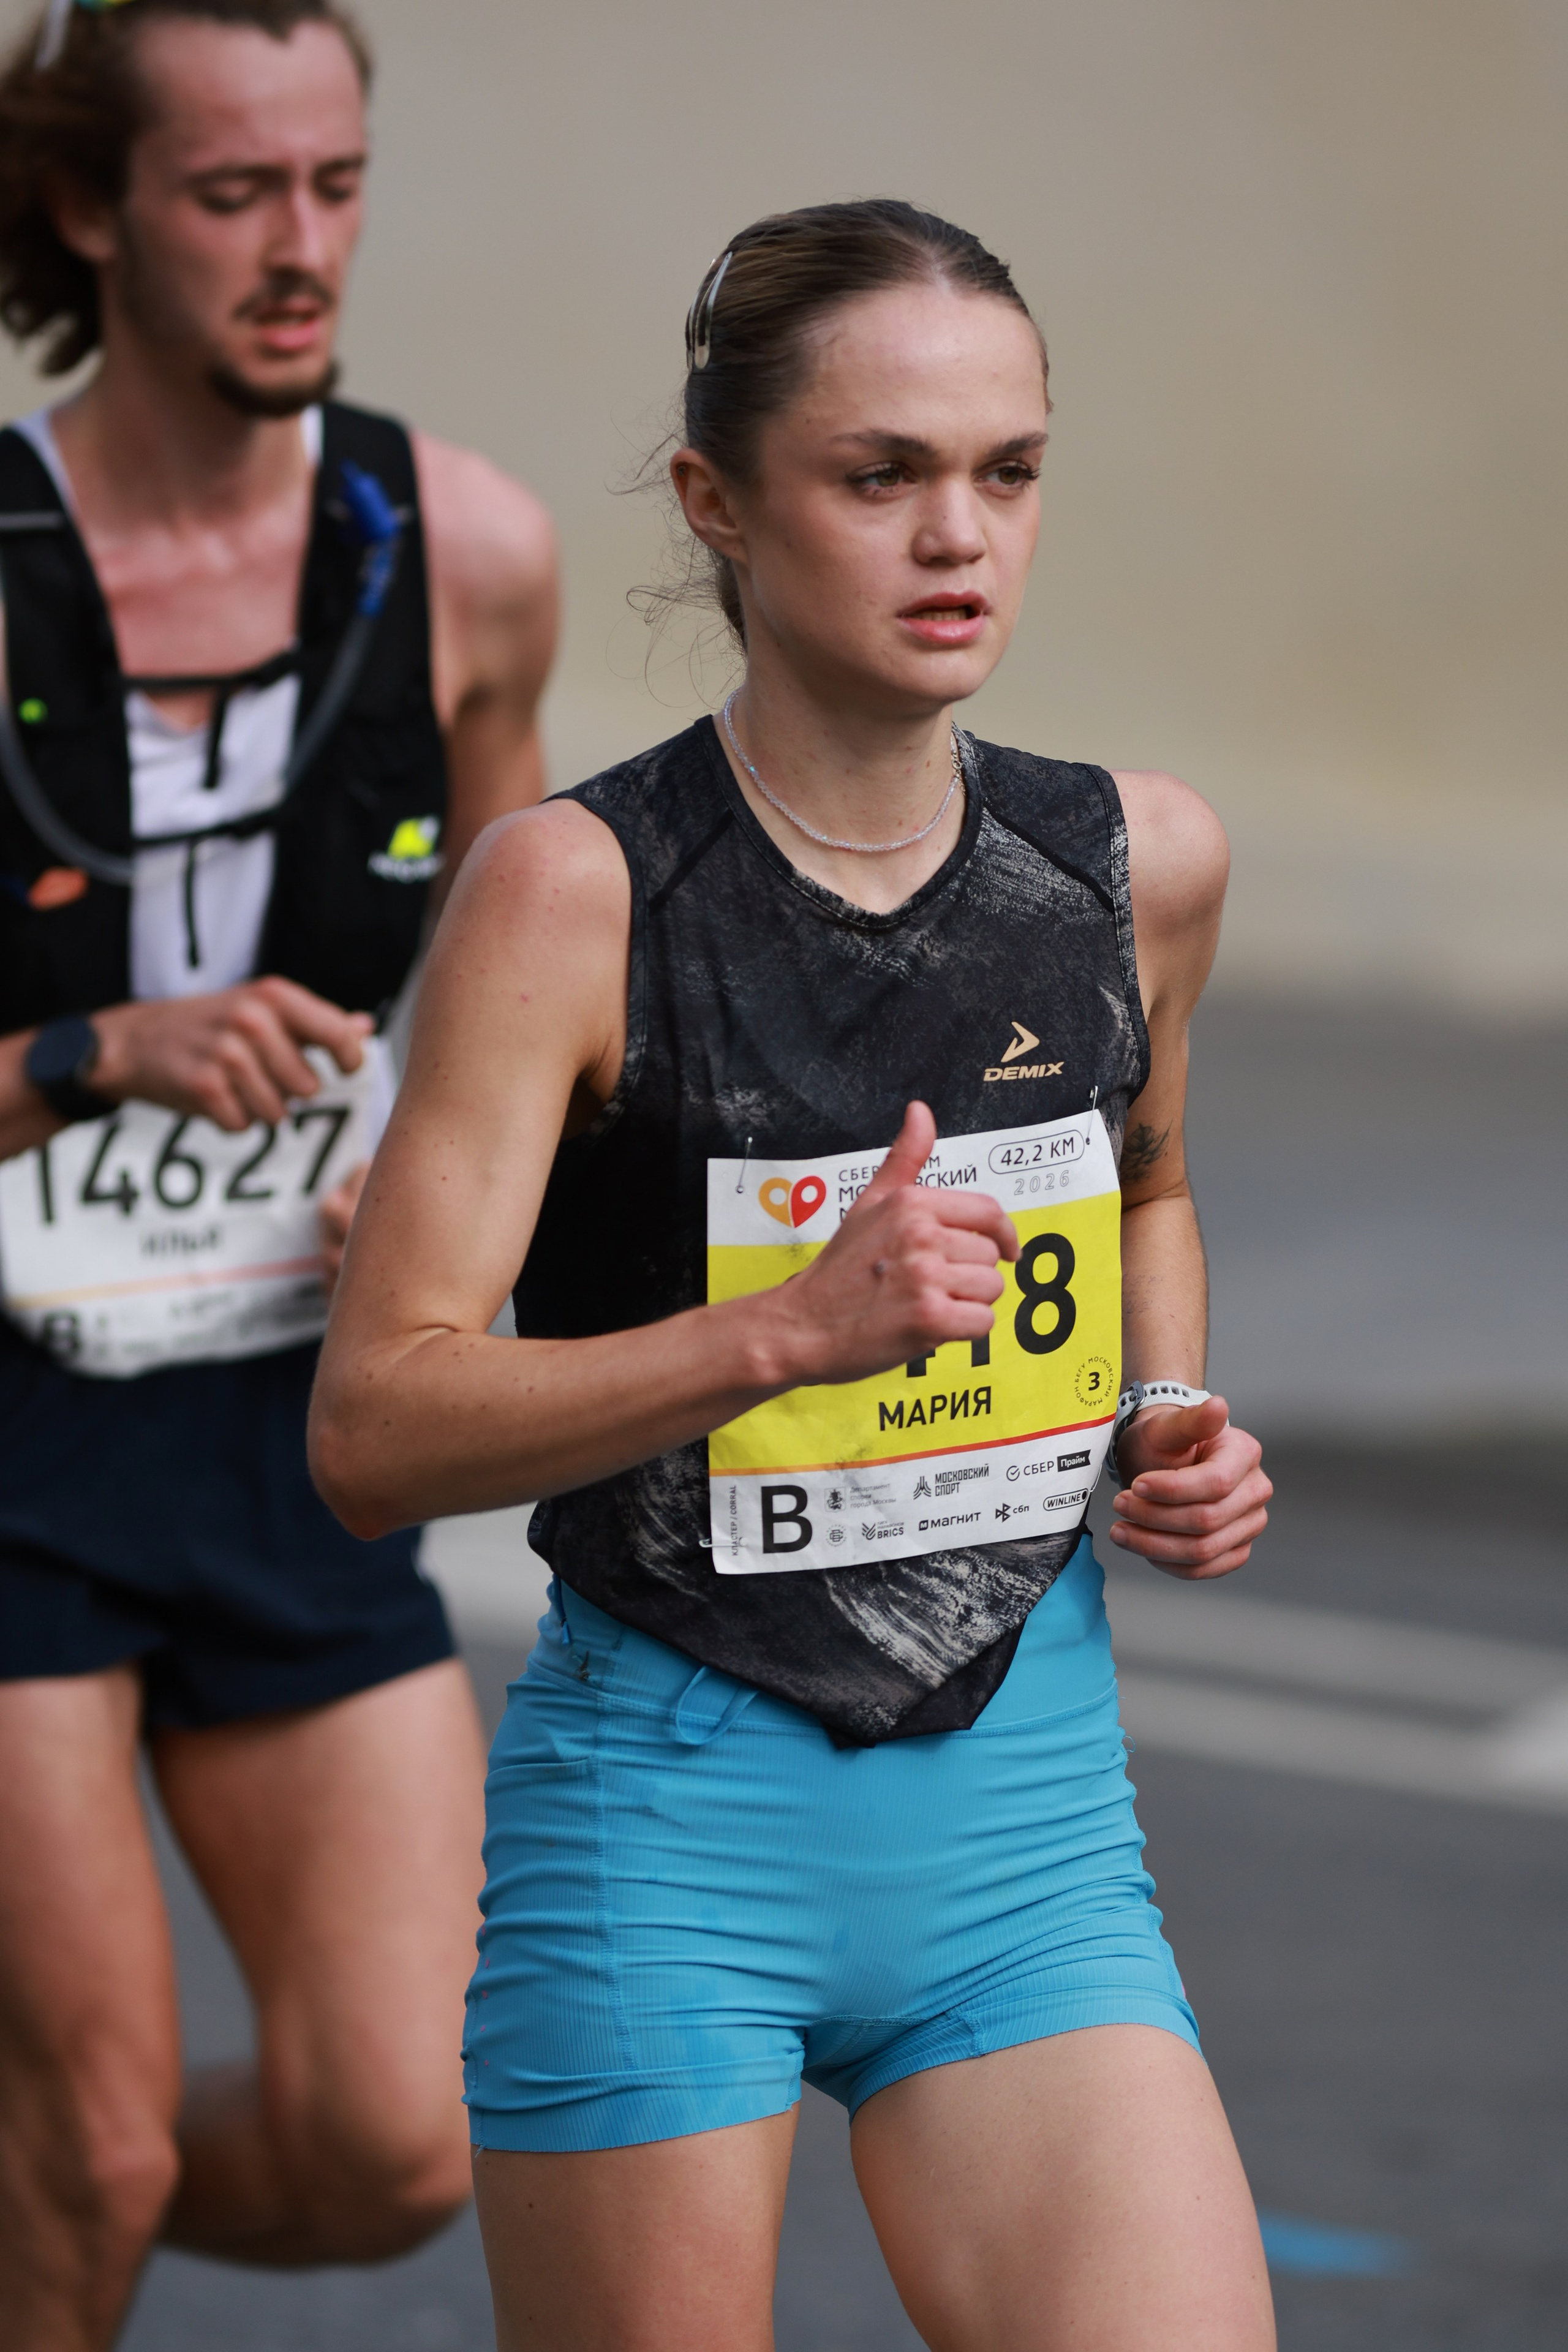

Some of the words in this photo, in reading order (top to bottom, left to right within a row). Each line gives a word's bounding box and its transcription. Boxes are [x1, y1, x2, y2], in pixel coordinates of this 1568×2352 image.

[983, 1061, 1065, 1082] DEMIX
[1000, 1145, 1042, 1166] 42,2
[1014, 1169, 1069, 1196] 2026
[1074, 1363, 1085, 1383] БЕГУ
[1088, 1356, 1114, 1397] МОСКОВСКИЙ
[1088, 1371, 1100, 1392] 3
[1074, 1386, 1103, 1407] МАРАФОН
[878, 1385, 992, 1432] МАРИЯ
[935, 1463, 989, 1485] МОСКОВСКИЙ
[1023, 1461, 1055, 1476] СБЕР
[1060, 1455, 1086, 1468] Прайм
[935, 1482, 960, 1496] СПОРТ
[1047, 1493, 1081, 1509] WINLINE
[877, 1527, 904, 1539] BRICS
